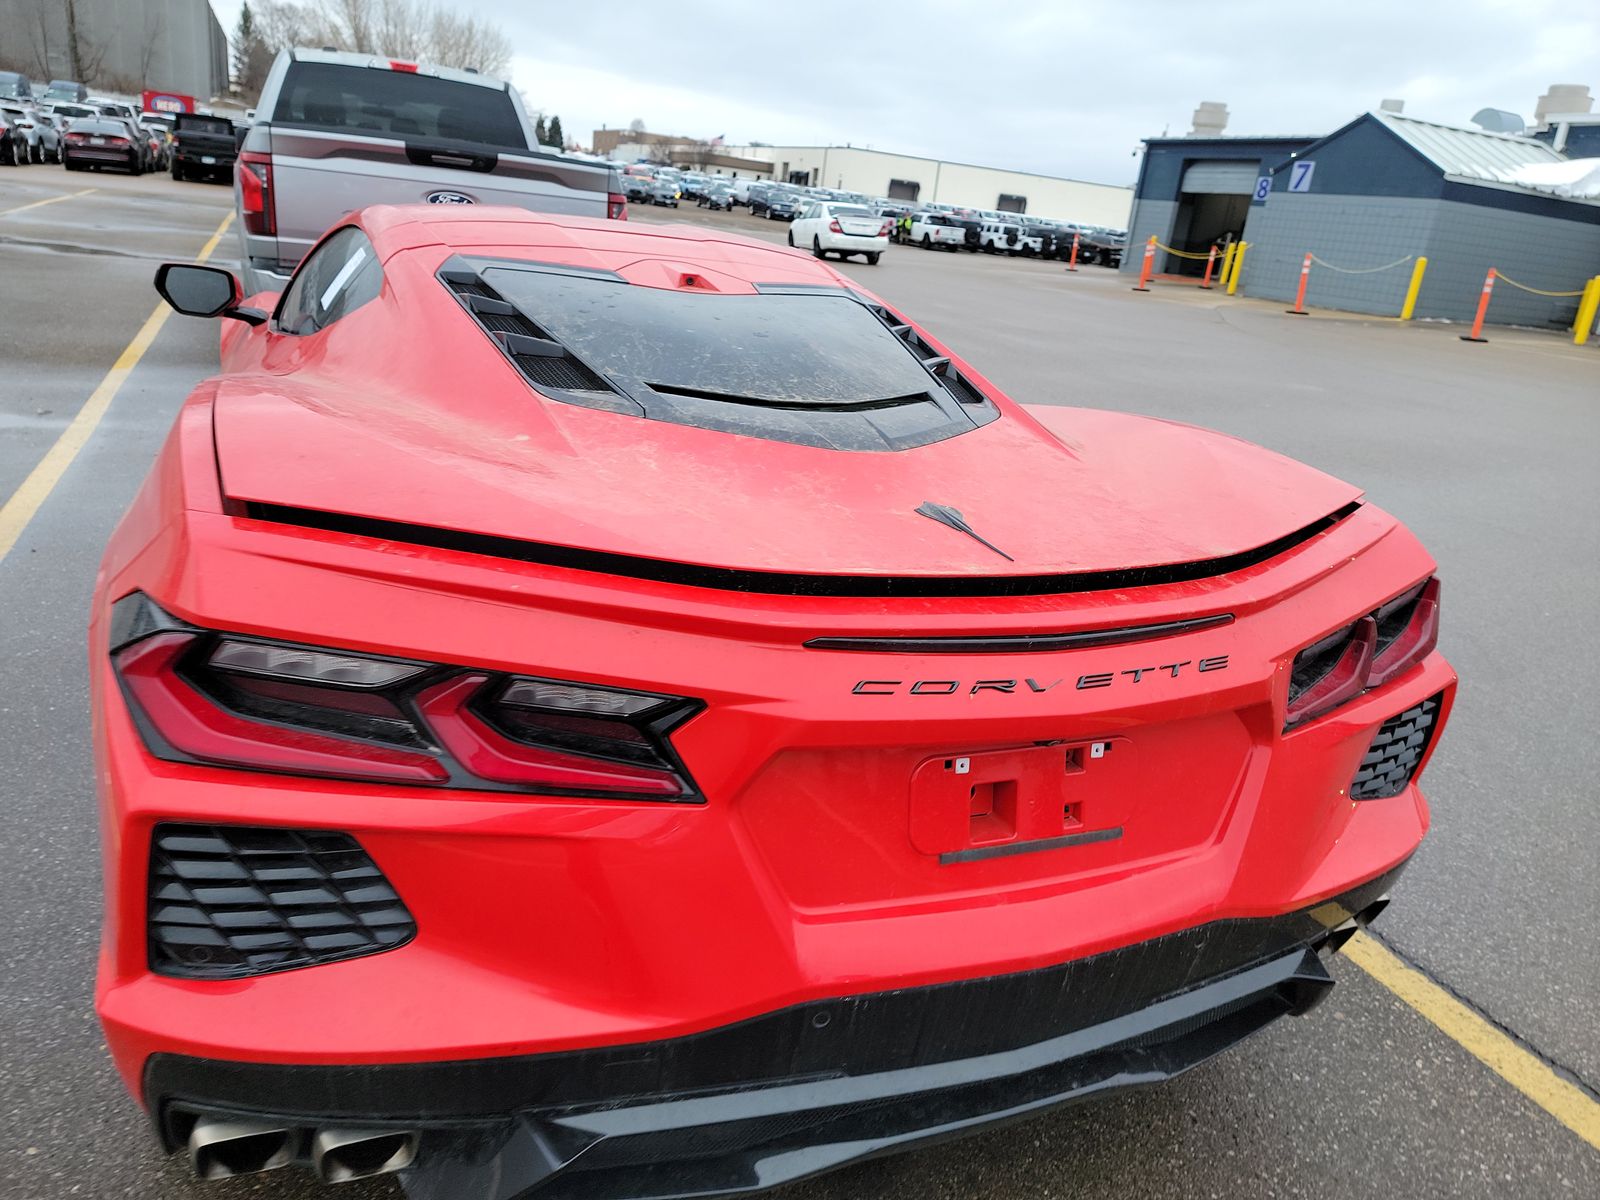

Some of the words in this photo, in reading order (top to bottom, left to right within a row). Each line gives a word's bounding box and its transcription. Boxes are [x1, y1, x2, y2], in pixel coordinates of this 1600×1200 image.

[1257, 179, 1269, 198] 8
[1294, 164, 1311, 189] 7
[851, 655, 1229, 695] CORVETTE
